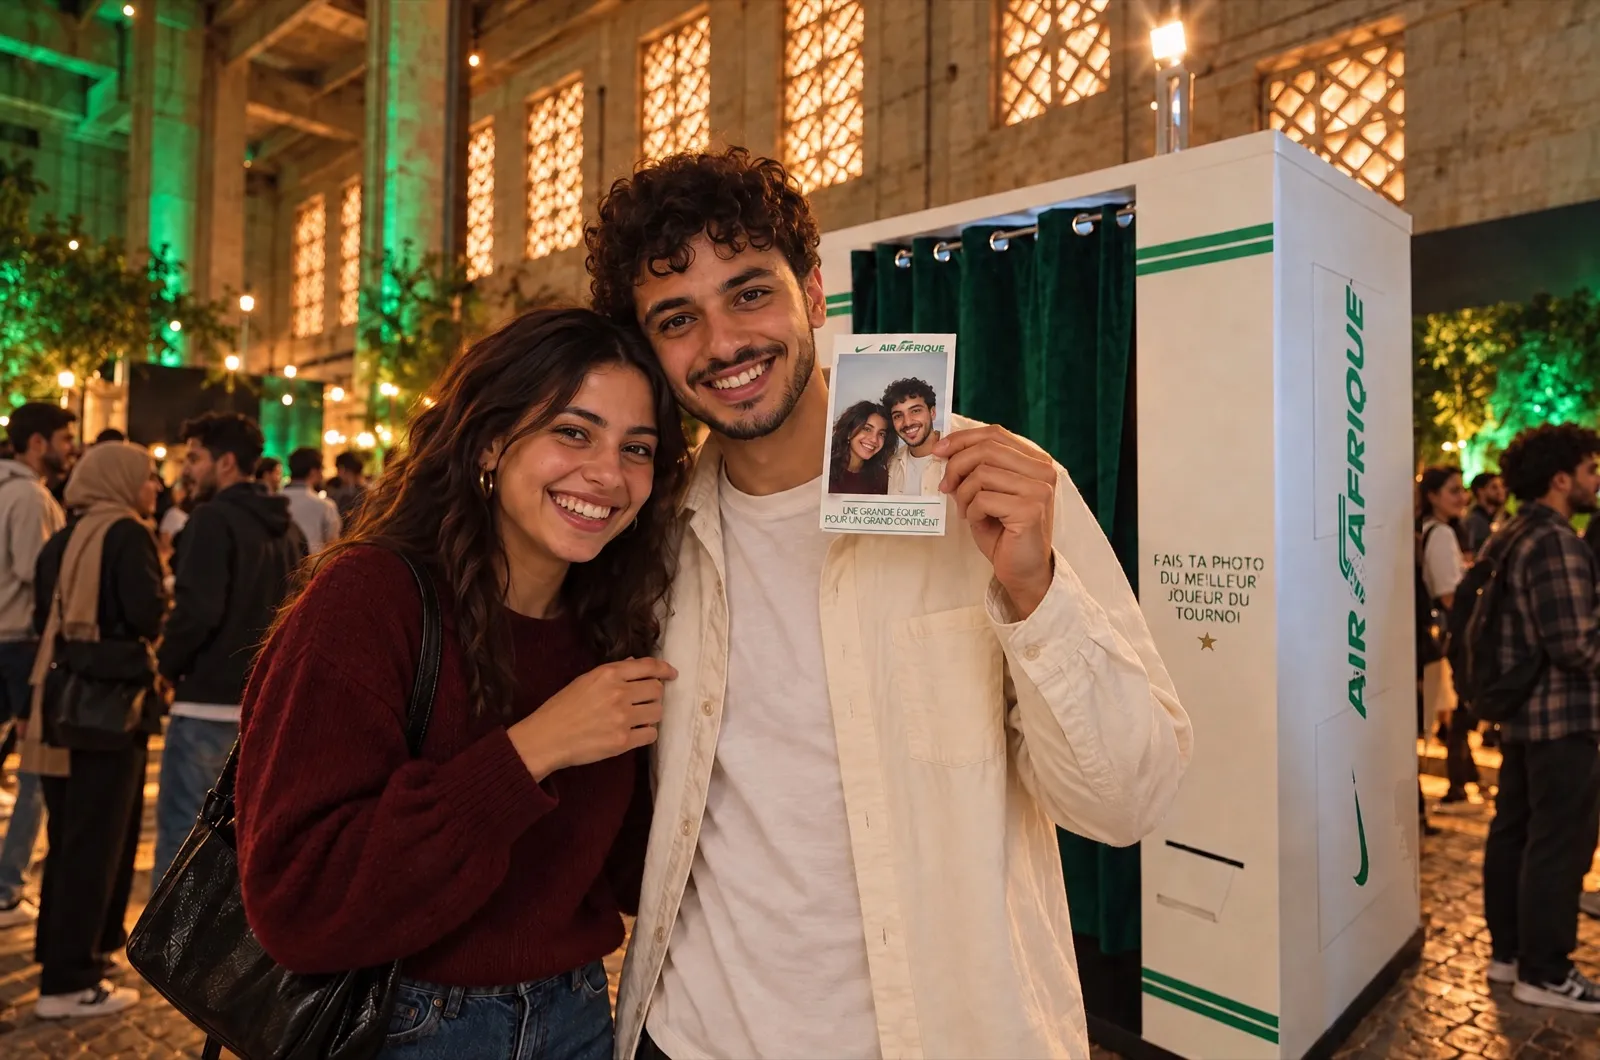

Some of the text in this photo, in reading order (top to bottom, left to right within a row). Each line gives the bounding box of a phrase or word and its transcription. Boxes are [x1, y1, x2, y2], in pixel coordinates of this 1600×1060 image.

[879, 344, 897, 352] AIR
[1346, 284, 1367, 719] AIR AFRIQUE
[842, 506, 925, 517] UNE GRANDE ÉQUIPE
[824, 514, 940, 527] POUR UN GRAND CONTINENT
[1154, 554, 1265, 571] FAIS TA PHOTO
[1160, 570, 1257, 589] DU MEILLEUR
[1168, 588, 1250, 607] JOUEUR DU
[1176, 606, 1241, 624] TOURNOI
